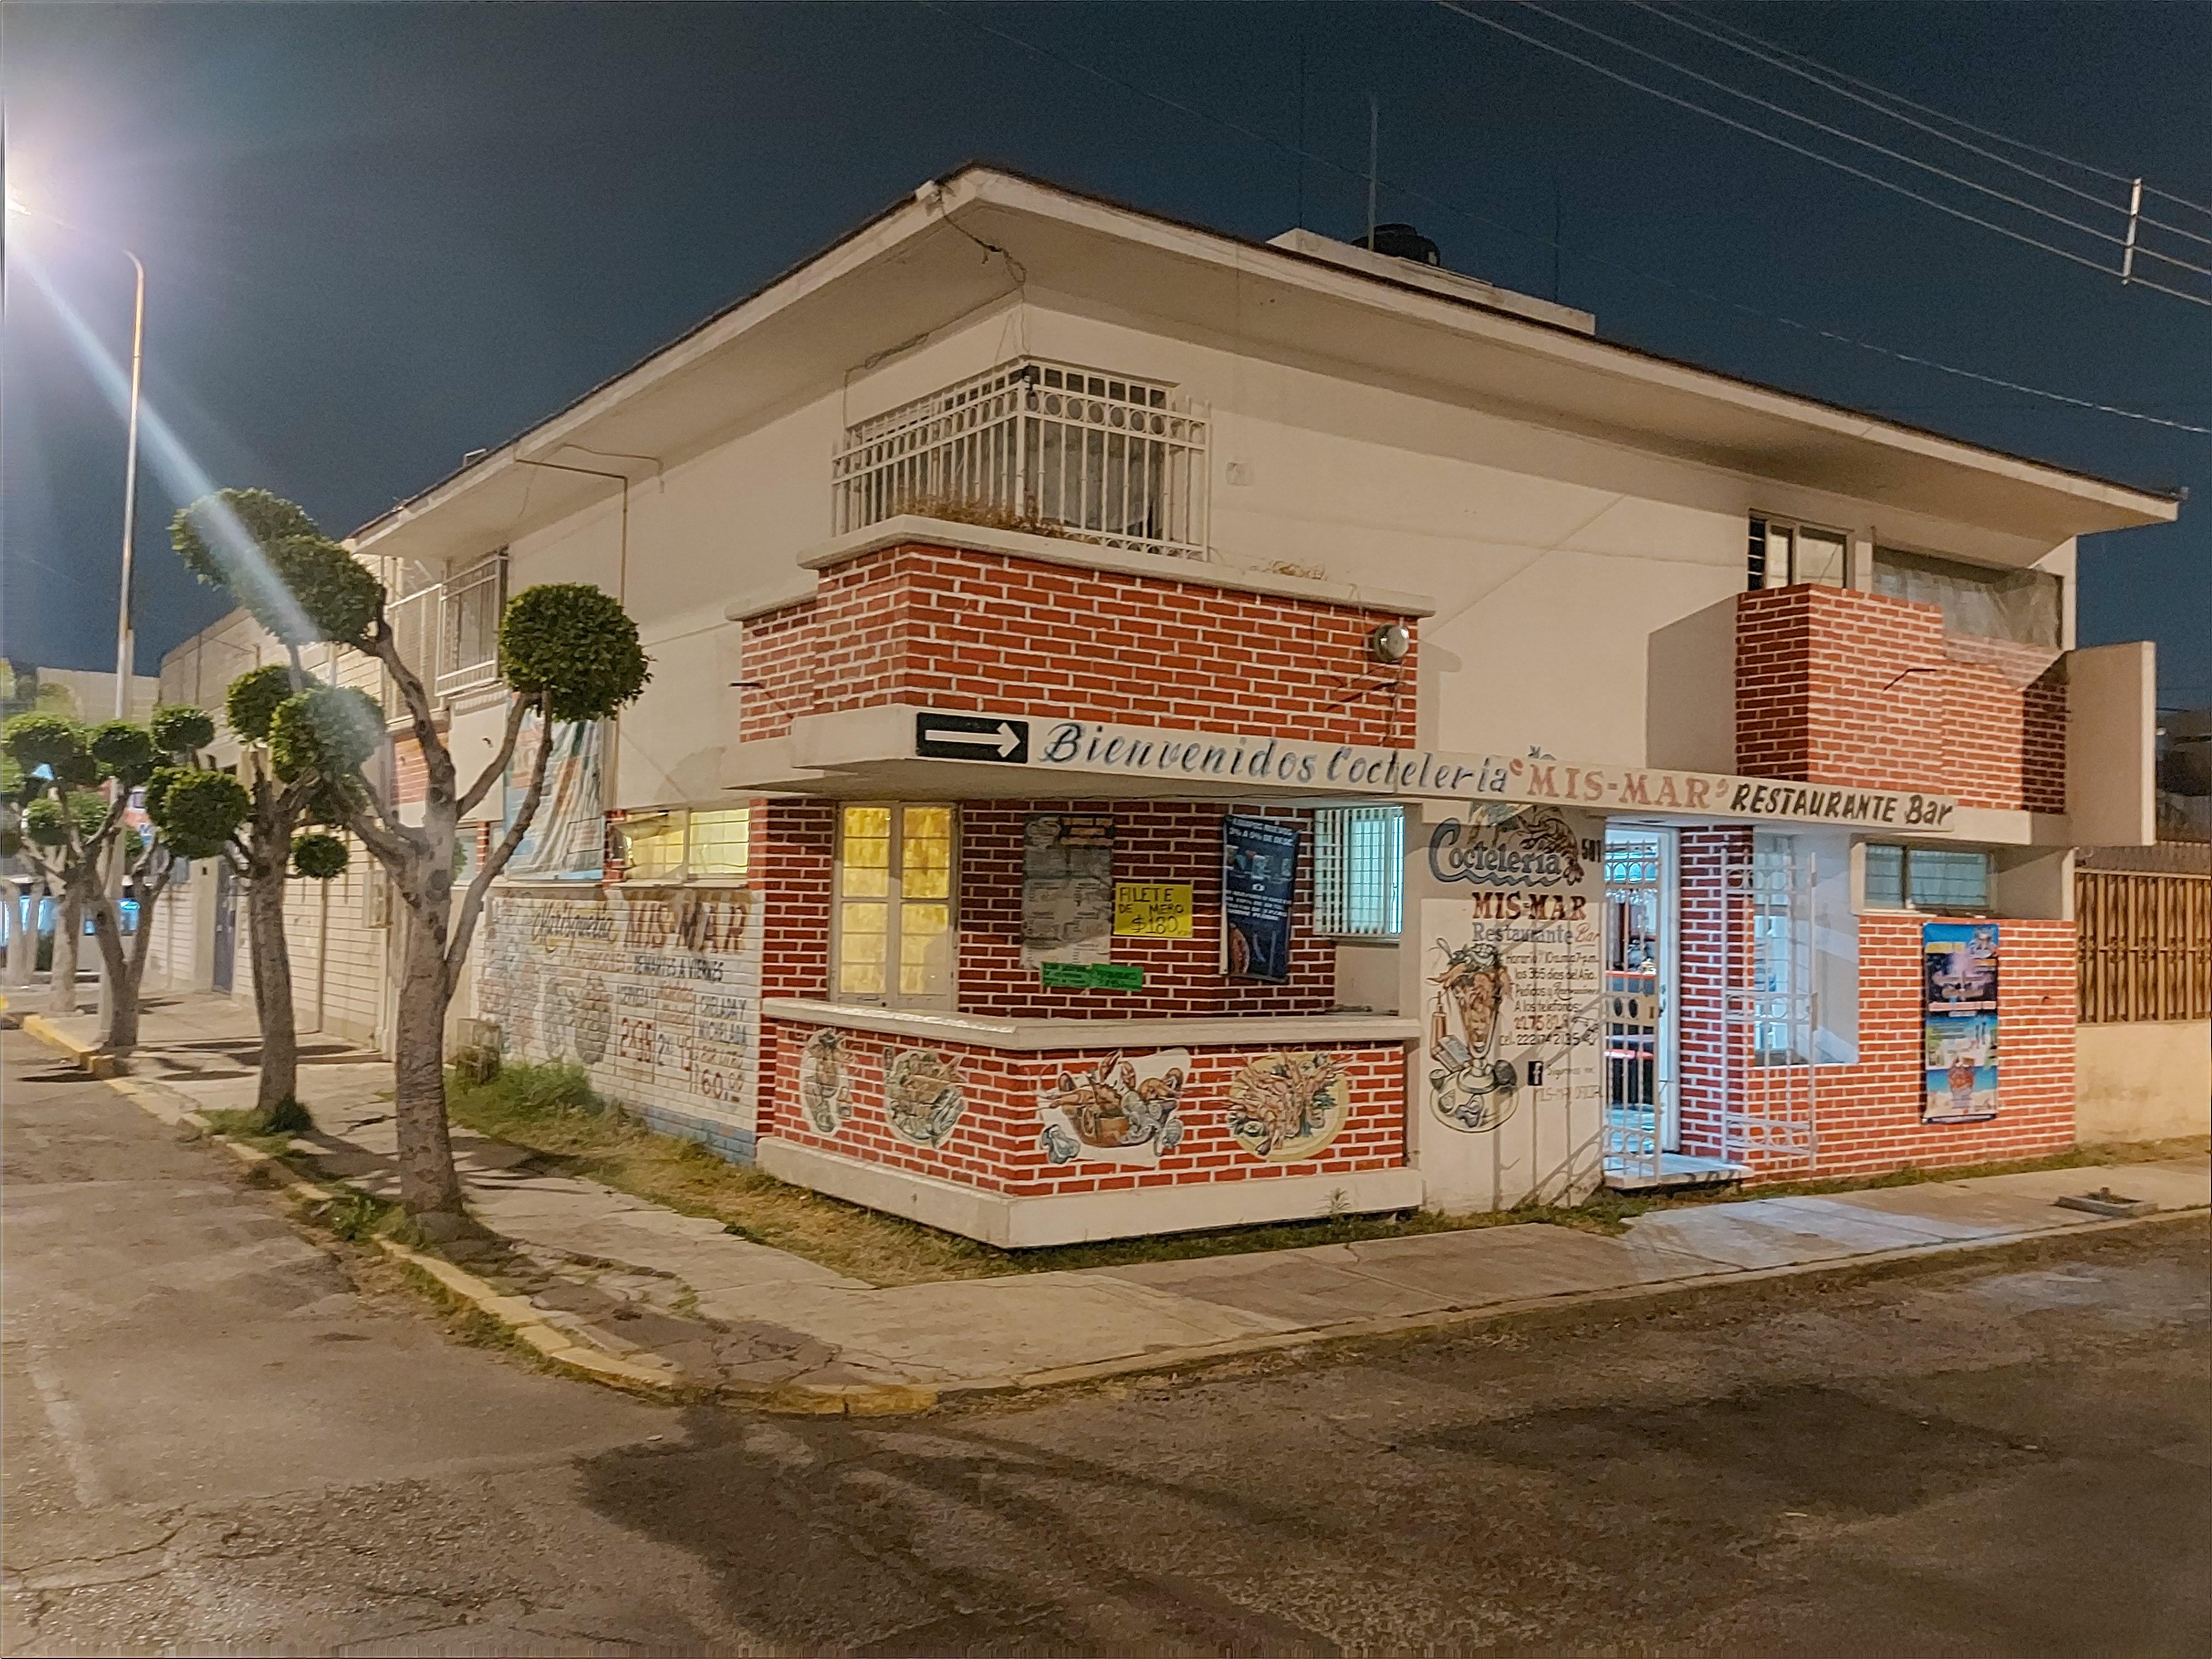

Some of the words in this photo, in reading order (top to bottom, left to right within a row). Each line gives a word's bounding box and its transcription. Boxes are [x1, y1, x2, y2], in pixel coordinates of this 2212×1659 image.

[1039, 722, 1318, 783] Bienvenidos
[1730, 783, 1899, 823] RESTAURANTE
[1905, 794, 1954, 826] Bar
[1119, 886, 1174, 902] FILETE
[1472, 891, 1587, 920] MIS-MAR
[1118, 903, 1133, 914] DE
[1149, 902, 1184, 914] MERO
[1472, 922, 1574, 945] Restaurante
[1574, 922, 1601, 942] Bar
